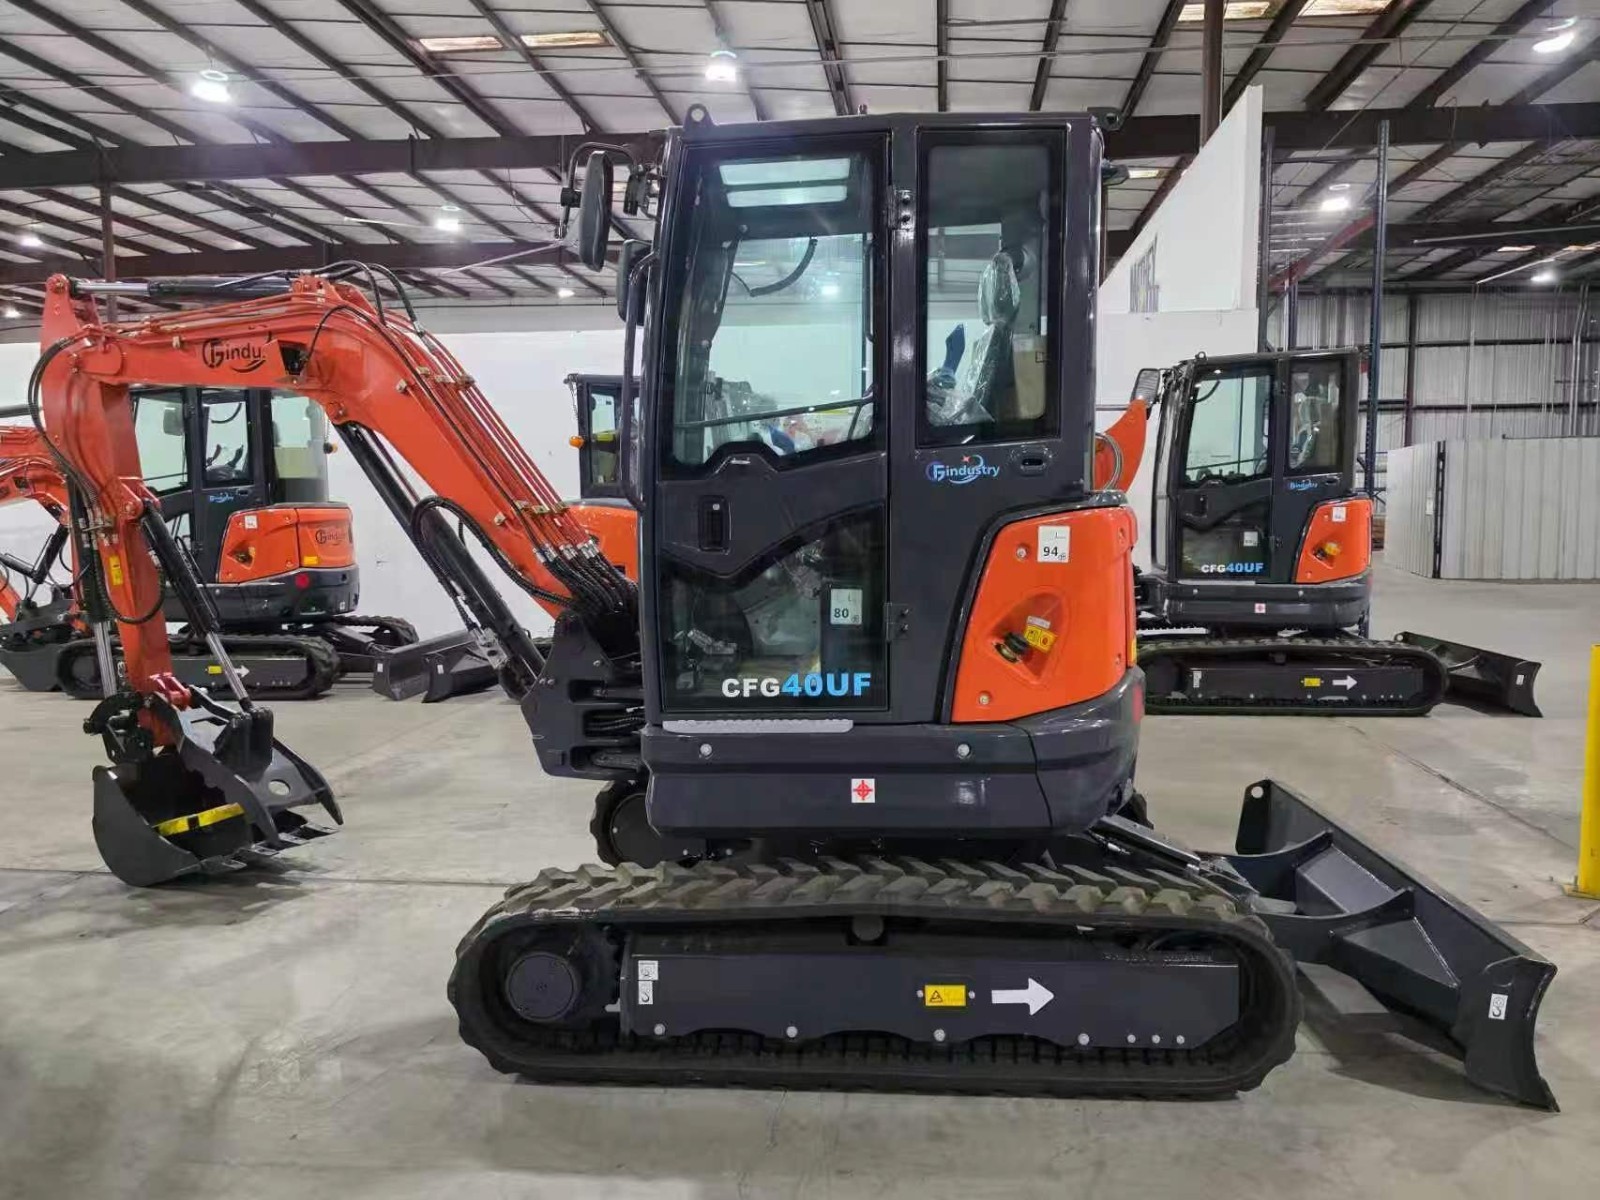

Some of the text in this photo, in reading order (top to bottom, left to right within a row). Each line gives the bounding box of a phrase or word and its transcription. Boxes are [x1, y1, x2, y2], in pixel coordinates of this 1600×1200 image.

[1043, 546, 1058, 557] 94
[1200, 562, 1264, 574] CFG40UF
[834, 607, 849, 619] 80
[721, 672, 872, 698] CFG40UF
